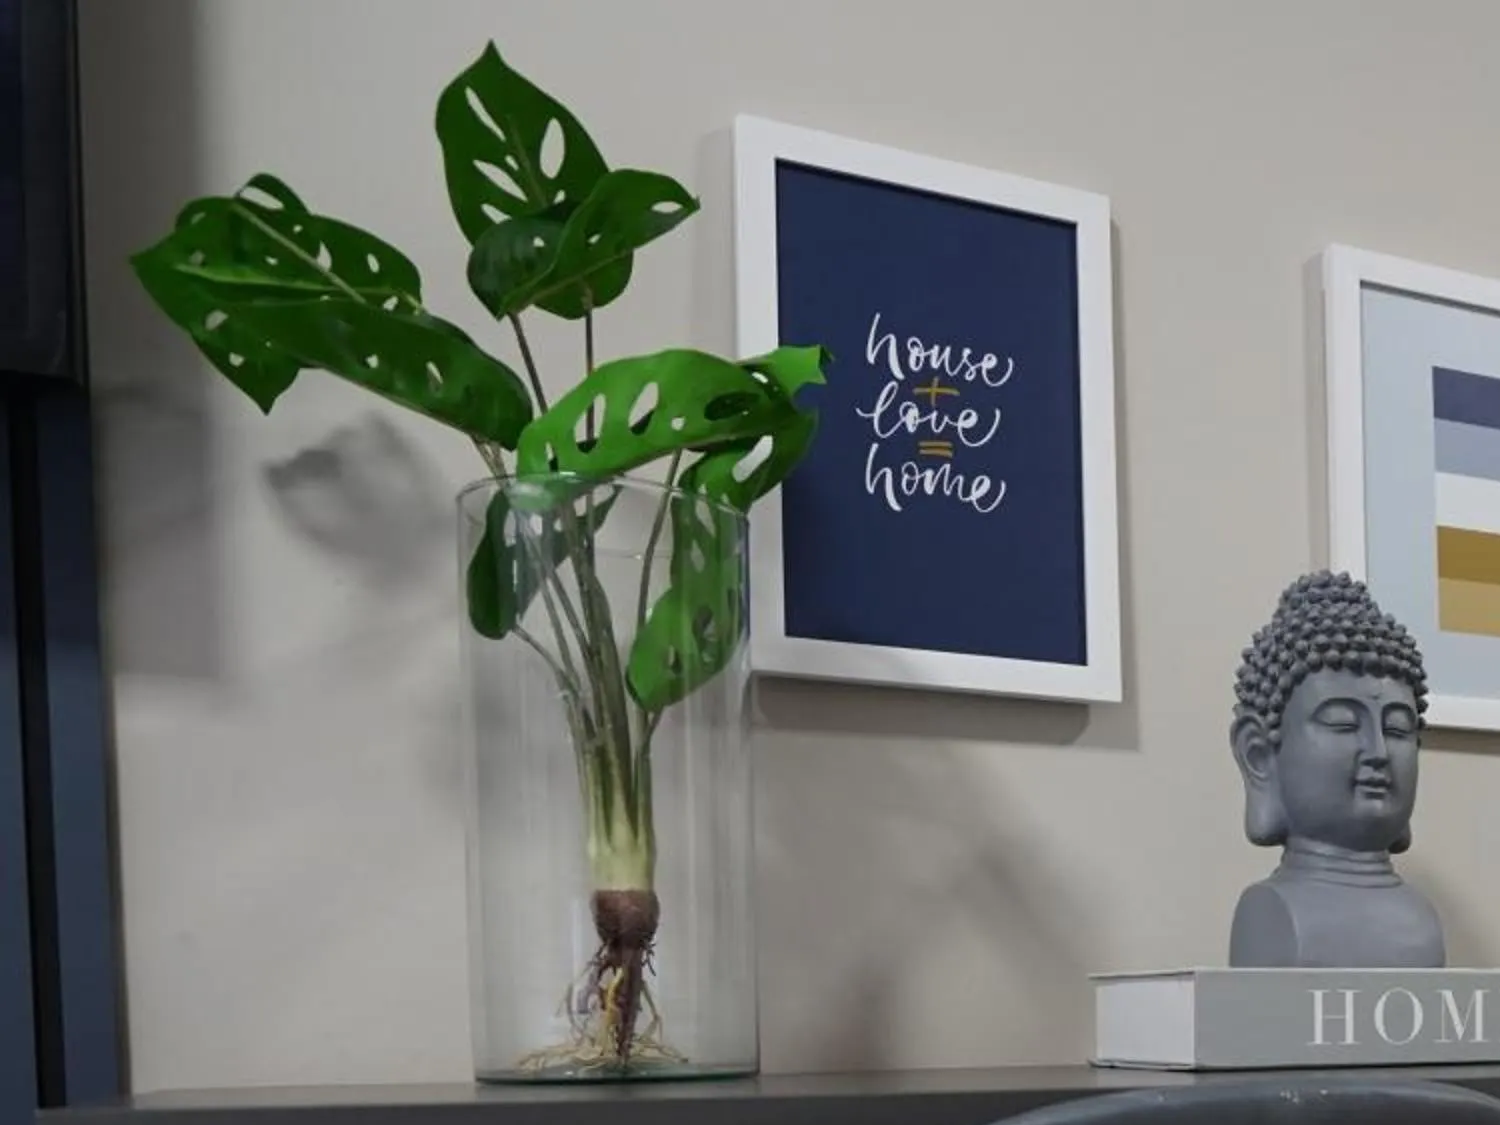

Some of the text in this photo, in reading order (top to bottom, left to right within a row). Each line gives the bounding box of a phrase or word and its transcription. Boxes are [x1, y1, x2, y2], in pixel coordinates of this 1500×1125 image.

[865, 312, 1014, 387] house
[855, 380, 1001, 447] love
[864, 442, 1007, 513] home
